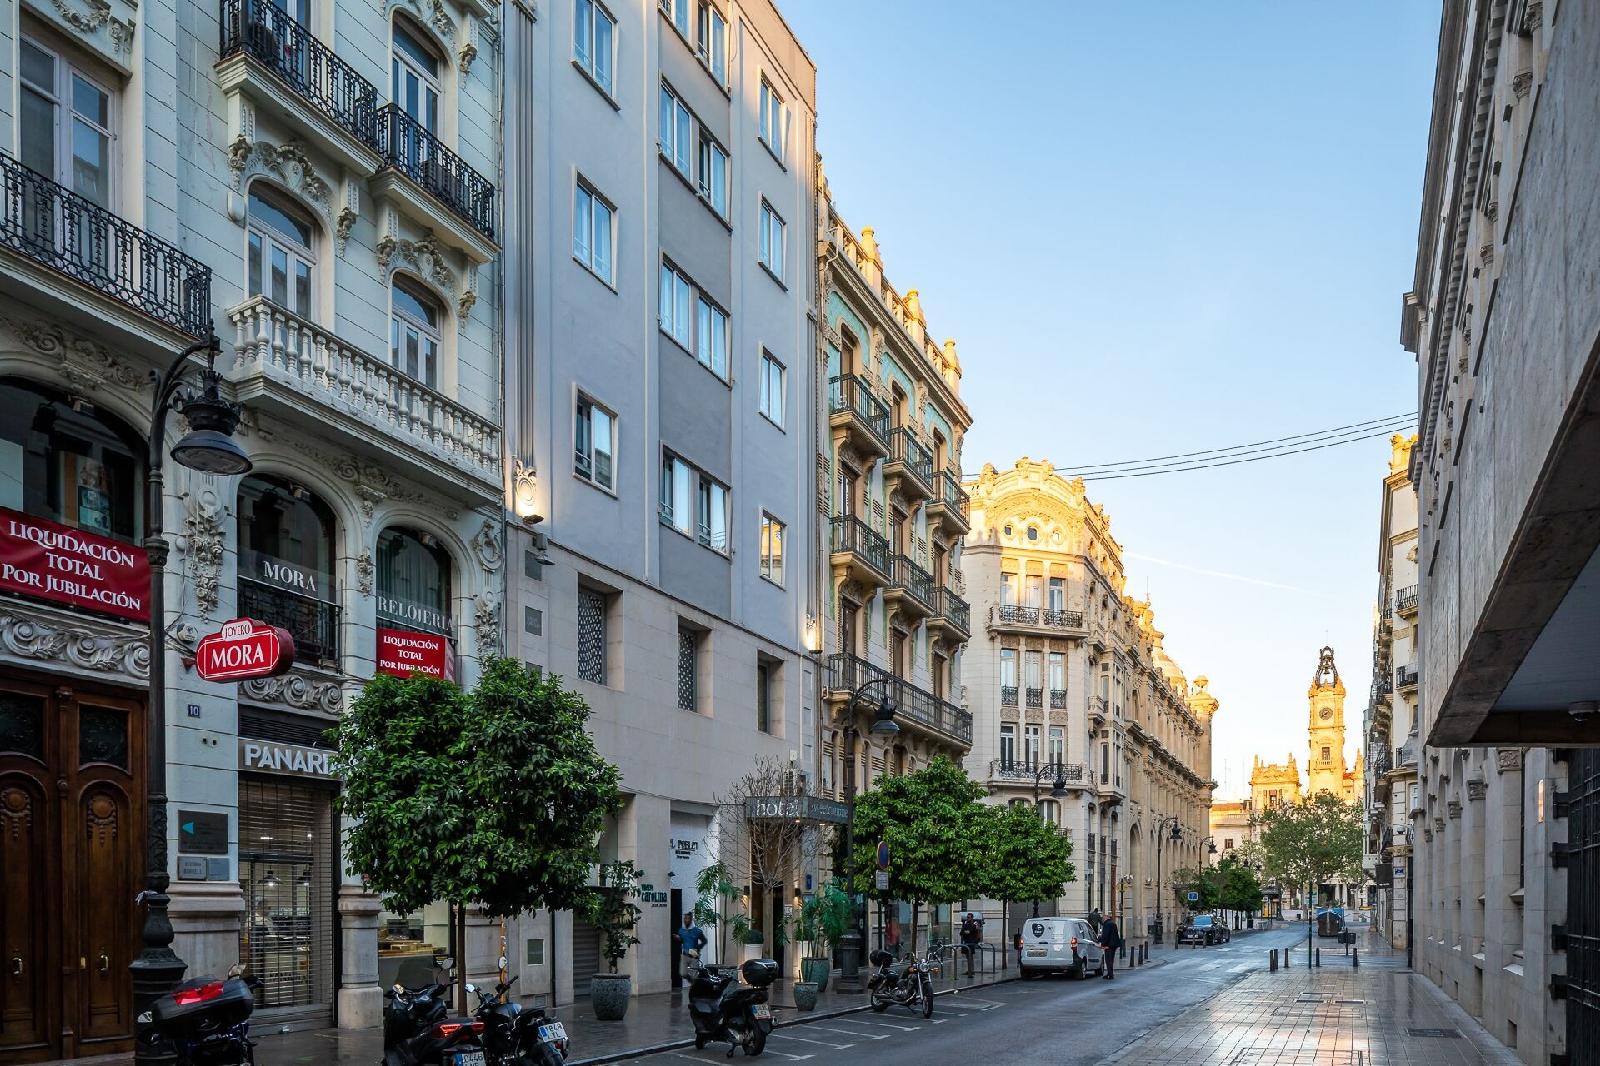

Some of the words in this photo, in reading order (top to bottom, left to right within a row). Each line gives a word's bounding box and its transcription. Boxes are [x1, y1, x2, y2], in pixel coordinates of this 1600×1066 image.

[9, 520, 135, 568] LIQUIDACIÓN
[45, 552, 104, 581] TOTAL
[263, 560, 317, 592] MORA
[2, 563, 43, 588] POR
[44, 573, 141, 611] JUBILACIÓN
[224, 624, 251, 639] JOYERO
[383, 635, 439, 651] LIQUIDACIÓN
[211, 642, 265, 669] MORA
[379, 659, 397, 670] POR
[397, 649, 424, 661] TOTAL
[189, 705, 199, 716] 10
